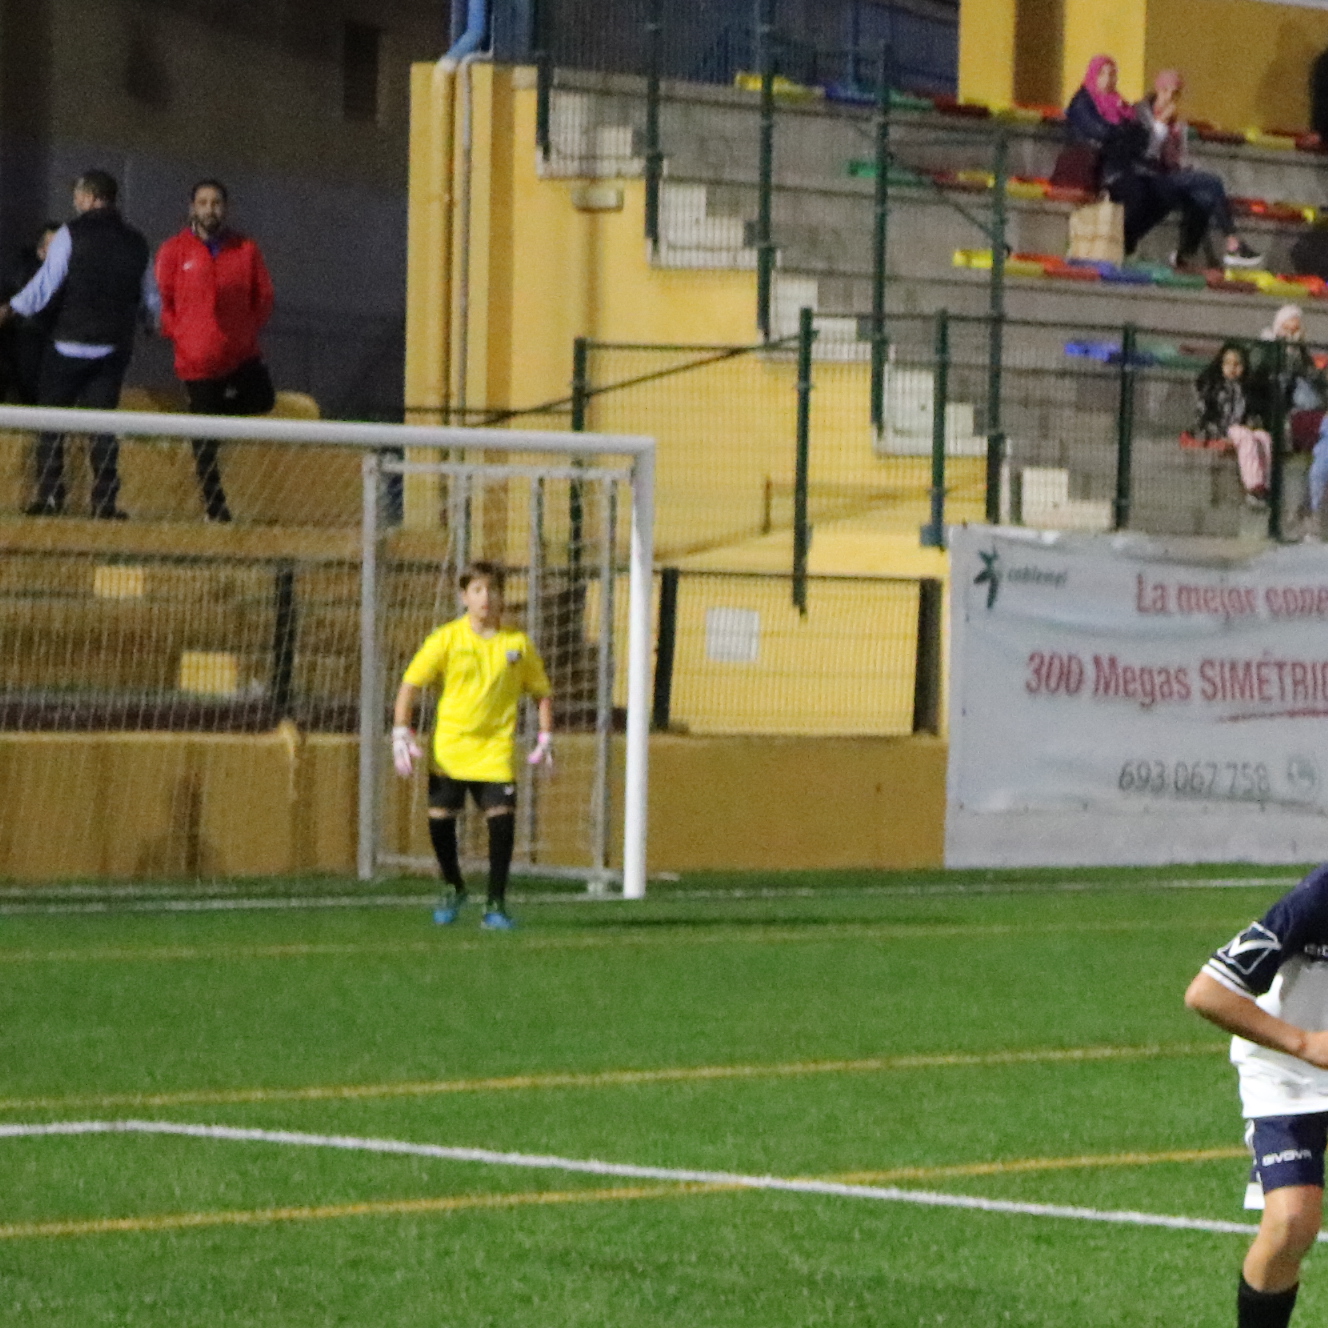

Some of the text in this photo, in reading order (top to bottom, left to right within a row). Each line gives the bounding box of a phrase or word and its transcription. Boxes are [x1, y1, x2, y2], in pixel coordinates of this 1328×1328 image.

[1137, 573, 1168, 614] La
[1177, 575, 1255, 625] mejor
[1026, 652, 1084, 694] 300
[1093, 655, 1191, 709] Megas
[1119, 759, 1166, 793] 693
